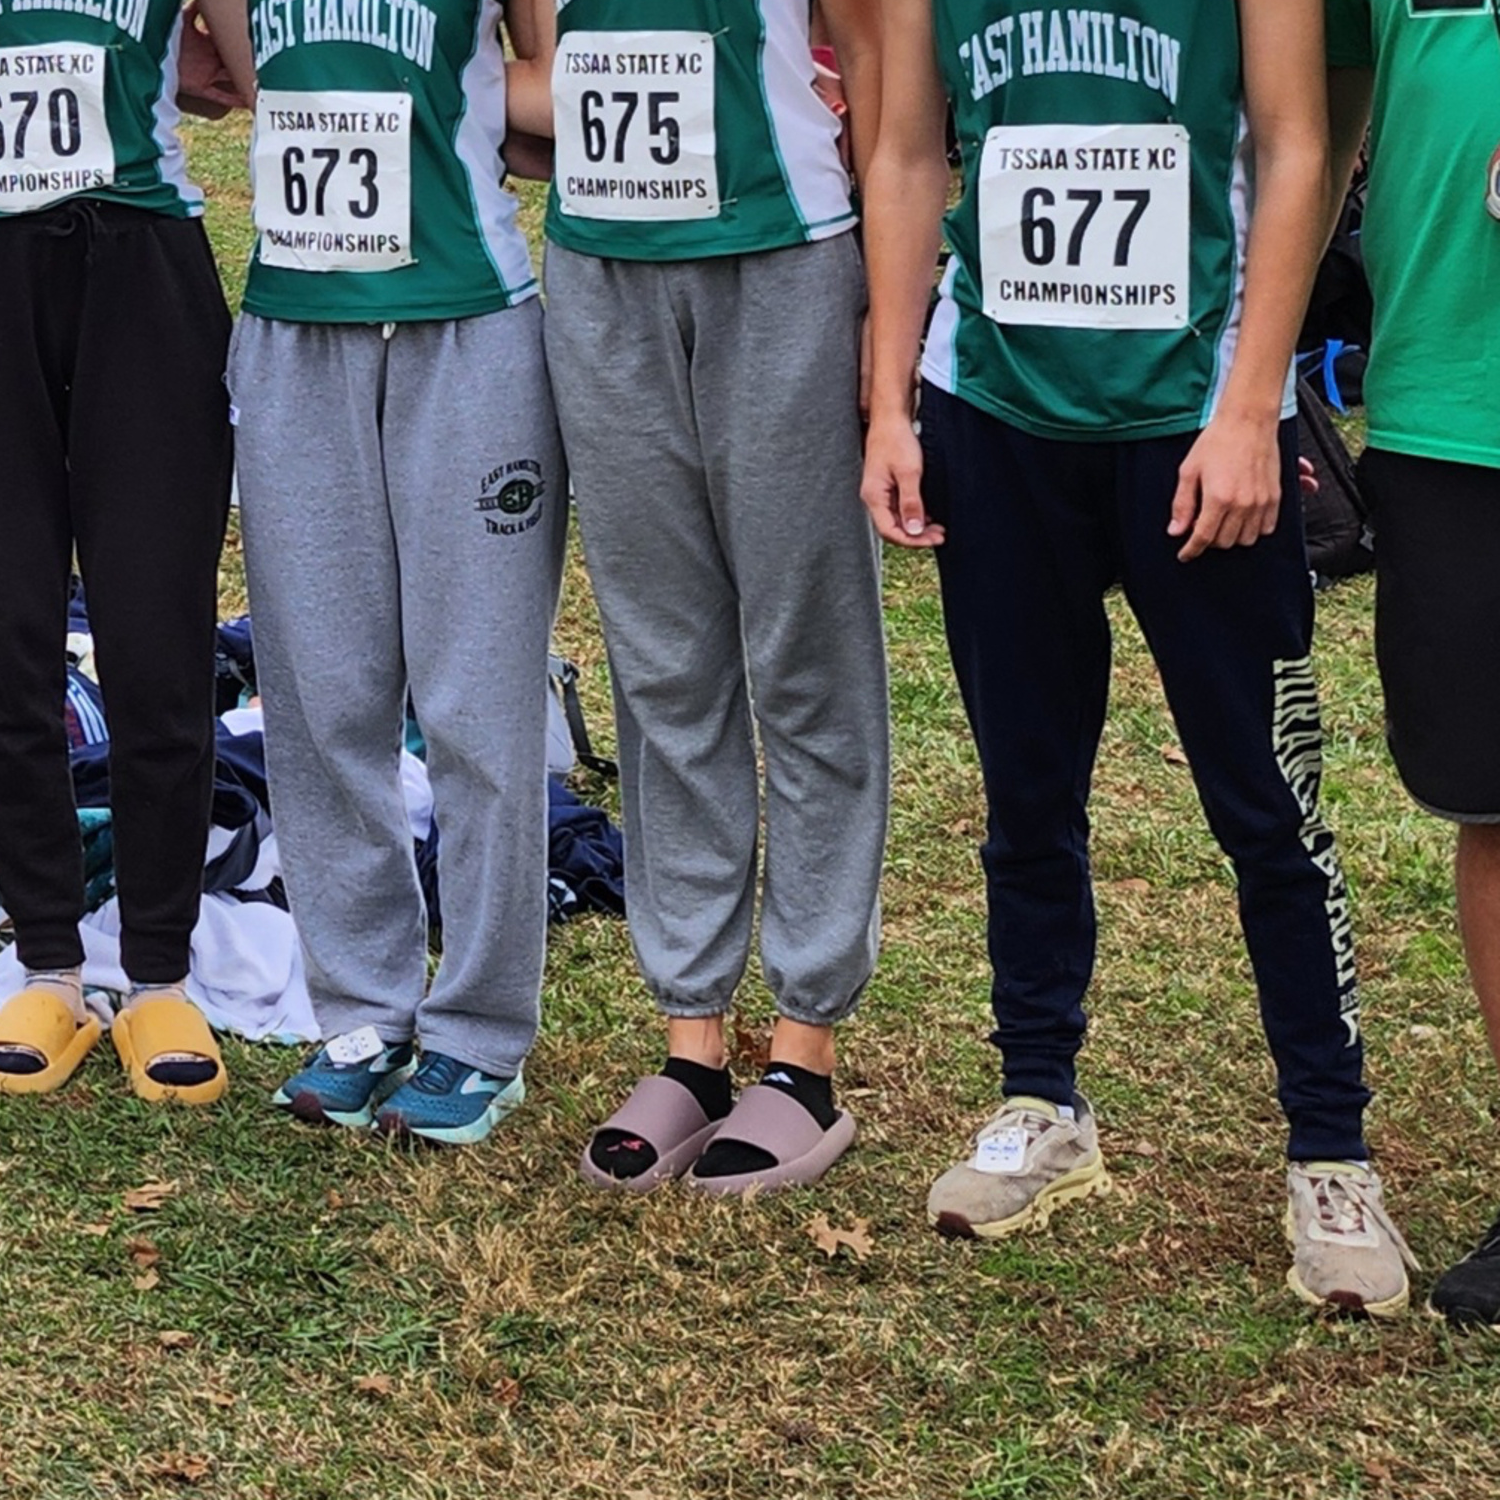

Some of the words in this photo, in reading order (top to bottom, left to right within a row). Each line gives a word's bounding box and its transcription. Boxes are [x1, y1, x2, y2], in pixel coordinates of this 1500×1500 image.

[14, 55, 66, 76] STATE
[70, 54, 95, 75] XC
[565, 52, 612, 75] TSSAA
[615, 52, 669, 75] STATE
[675, 52, 703, 75] XC
[1019, 9, 1181, 104] HAMILTON
[269, 111, 316, 133] TSSAA
[319, 111, 369, 133] STATE
[375, 112, 400, 133] XC
[580, 90, 680, 166] 675
[1000, 148, 1068, 170] TSSAA
[1075, 148, 1140, 171] STATE
[1148, 148, 1176, 171] XC
[282, 146, 380, 219] 673
[567, 176, 708, 200] CHAMPIONSHIPS
[1020, 187, 1151, 267] 677
[266, 229, 401, 254] CHAMPIONSHIPS
[999, 280, 1177, 306] CHAMPIONSHIPS
